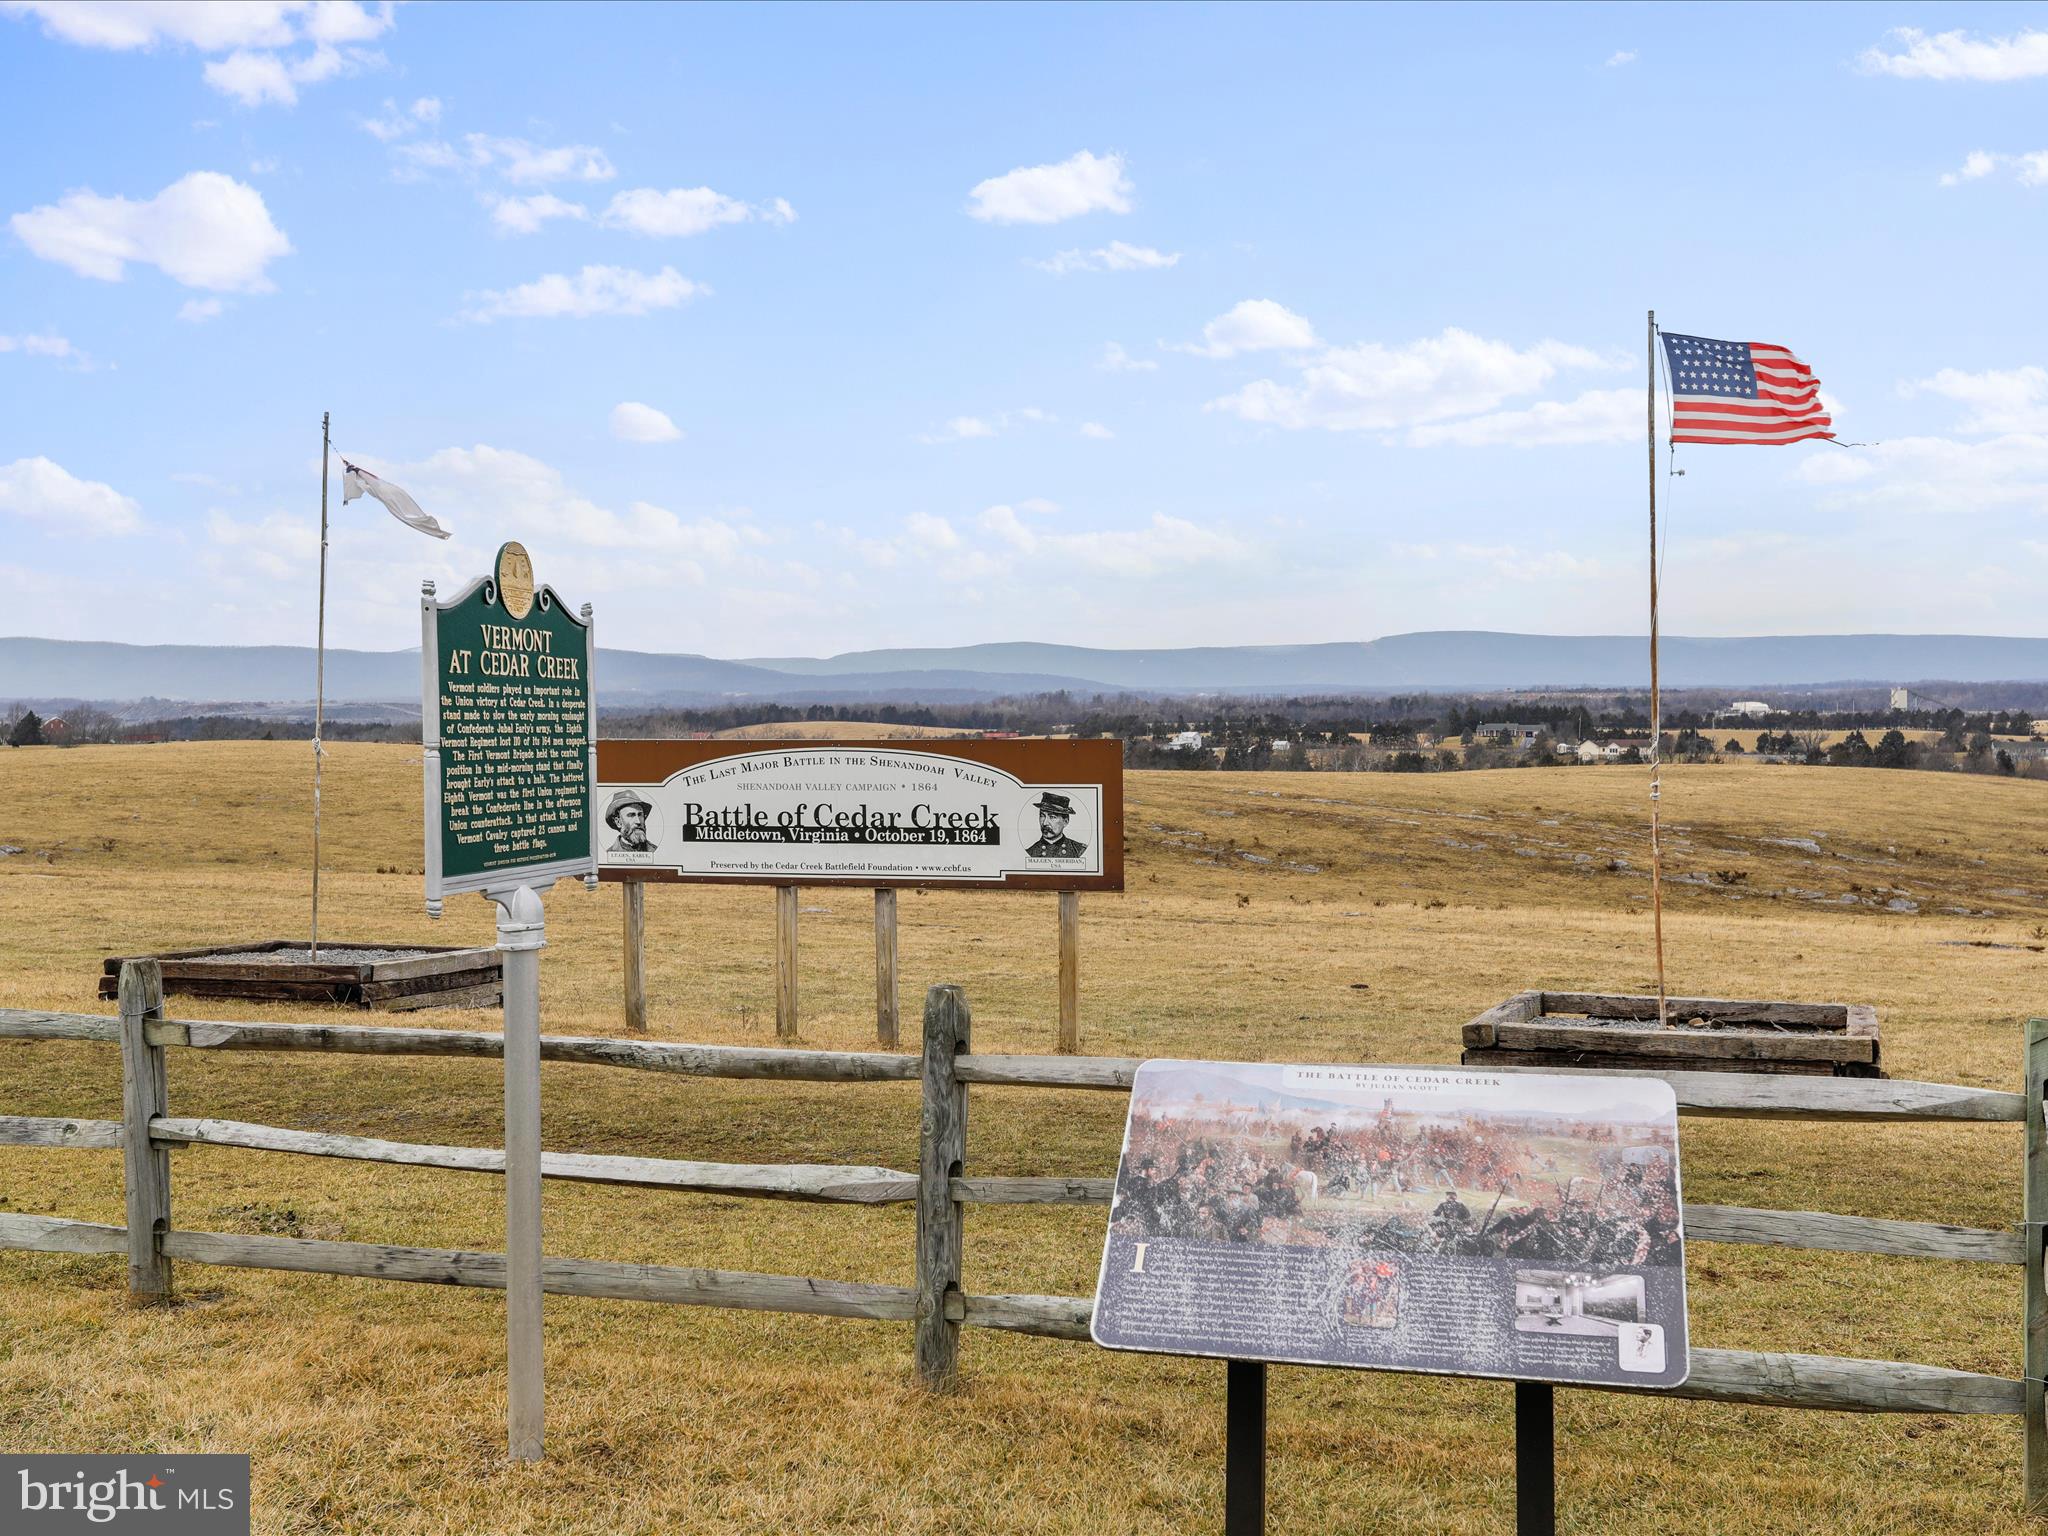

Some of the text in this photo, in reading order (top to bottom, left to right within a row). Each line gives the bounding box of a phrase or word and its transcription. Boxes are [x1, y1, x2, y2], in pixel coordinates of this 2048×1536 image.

[480, 624, 552, 652] VERMONT
[450, 650, 580, 680] AT CEDAR CREEK
[448, 682, 580, 696] Vermont soldiers played an important role in
[441, 696, 452, 706] the
[455, 696, 474, 706] Union
[476, 696, 498, 708] victory
[500, 698, 506, 706] at
[510, 697, 526, 707] Cedar
[528, 698, 546, 708] Creek.
[548, 698, 554, 708] In
[562, 699, 586, 710] desperate
[452, 748, 578, 761] The First Vermont Brigade held the central
[683, 775, 706, 786] THE
[710, 768, 736, 780] LAST
[740, 760, 779, 773] MAJOR
[784, 756, 826, 768] BATTLE
[870, 756, 944, 775] SHENANDOAH
[954, 768, 997, 788] VALLEY
[444, 792, 464, 804] Eighth
[468, 791, 494, 802] Vermont
[510, 789, 519, 798] the
[522, 788, 535, 798] first
[538, 786, 552, 796] Union
[554, 786, 578, 796] regiment
[580, 784, 586, 792] to
[451, 798, 581, 816] break the Confederate line in the afternoon
[684, 803, 1000, 828] Battle of Cedar Creek
[457, 832, 482, 844] Vermont
[486, 830, 508, 842] Cavalry
[510, 826, 536, 839] captured
[548, 824, 566, 834] cannon
[568, 822, 578, 831] and
[696, 827, 986, 844] Middletown, Virginia October 19, 1864
[750, 862, 759, 870] by
[1329, 1073, 1378, 1081] BATTLE
[1406, 1076, 1450, 1084] CEDAR
[1456, 1078, 1501, 1086] CREEK
